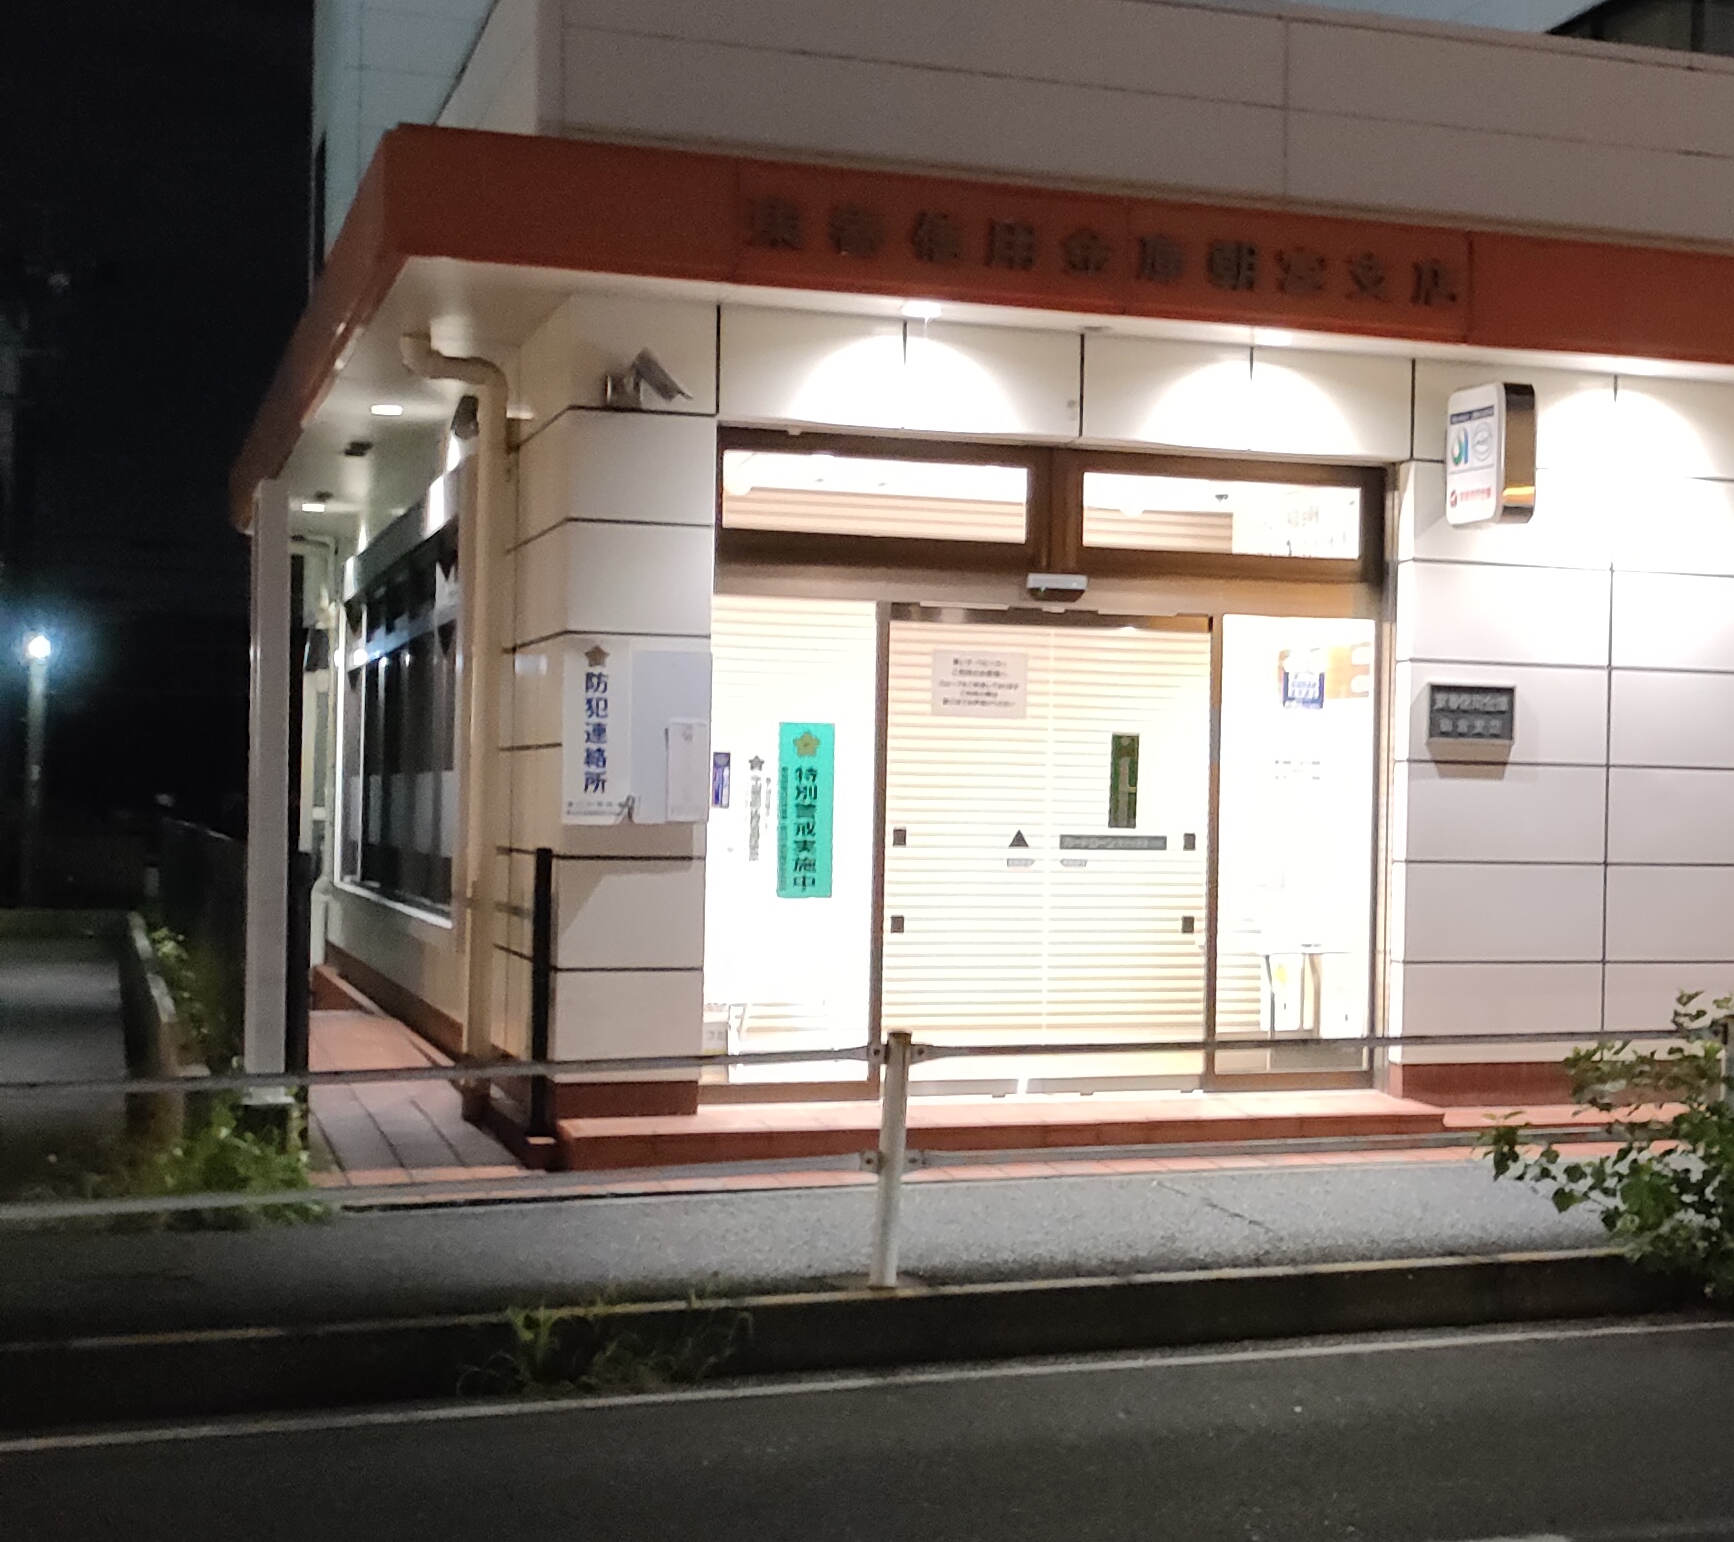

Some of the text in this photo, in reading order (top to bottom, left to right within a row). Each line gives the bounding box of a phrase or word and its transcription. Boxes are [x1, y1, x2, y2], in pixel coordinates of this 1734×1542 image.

[584, 672, 608, 794] 防犯連絡所
